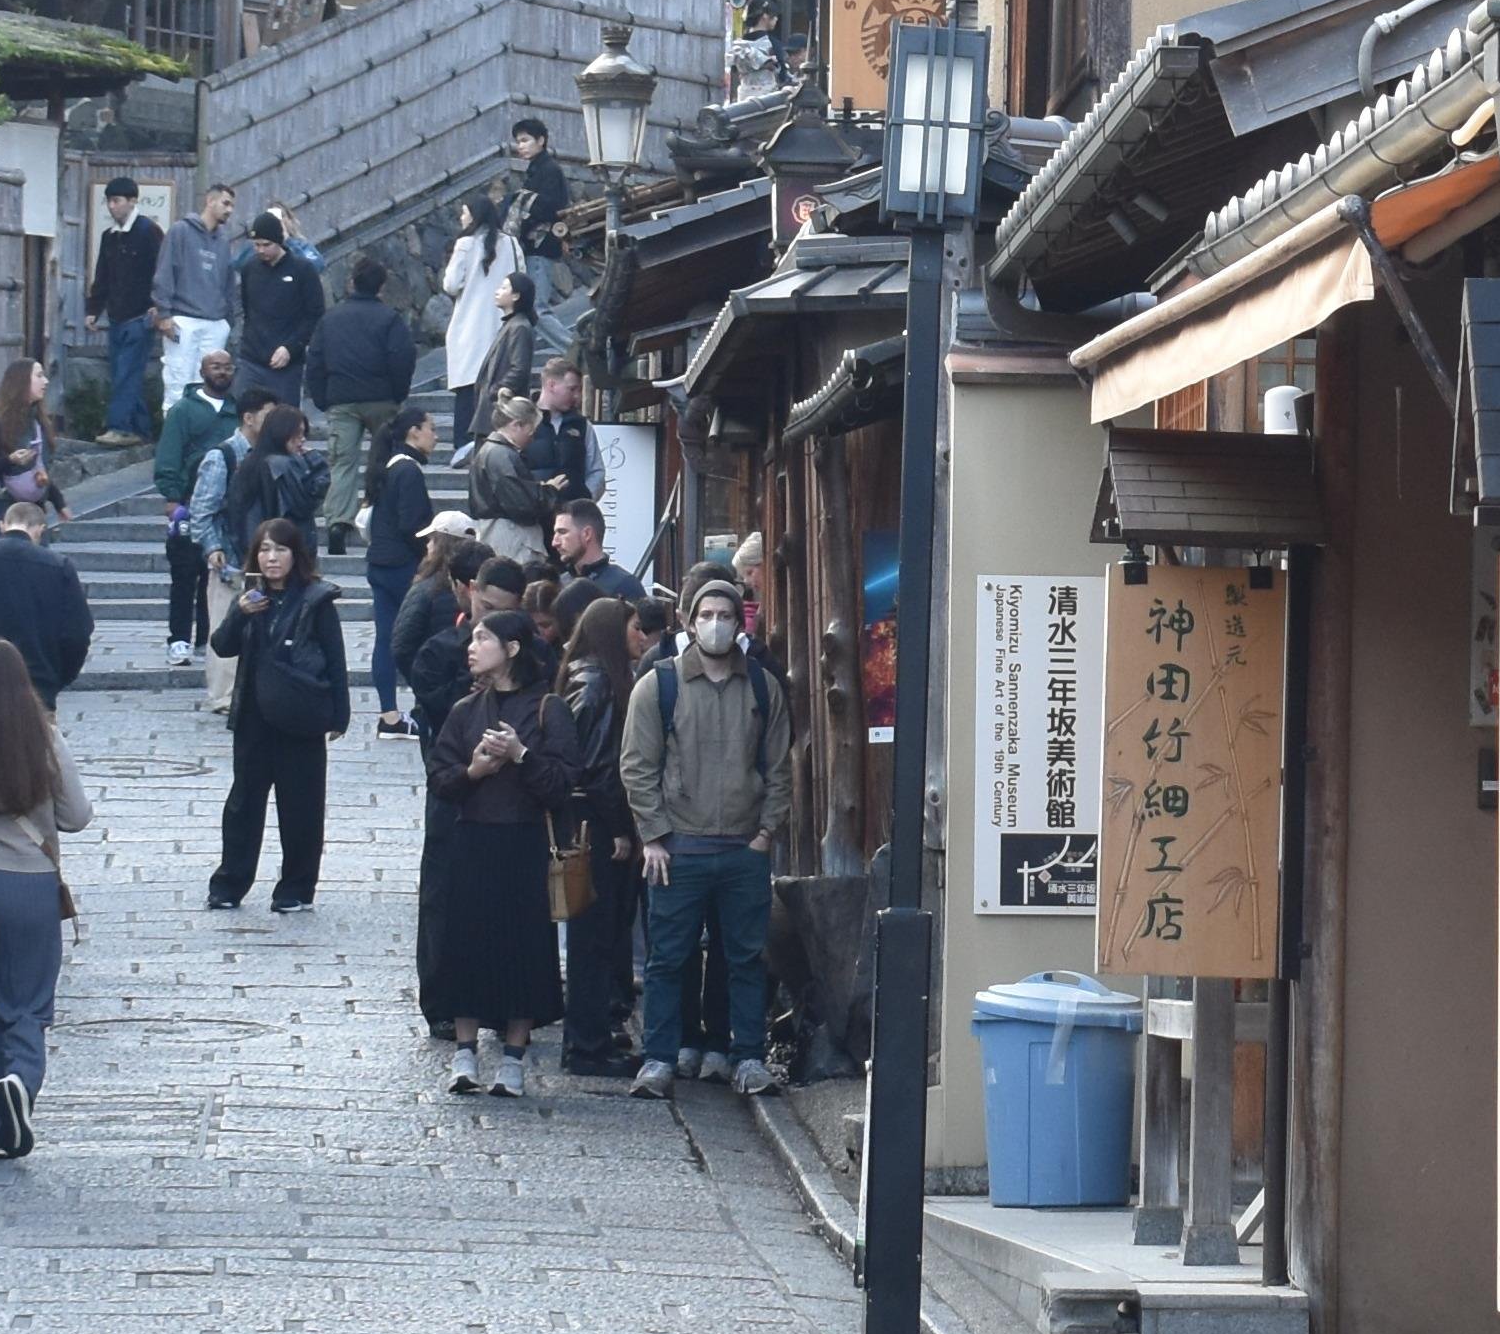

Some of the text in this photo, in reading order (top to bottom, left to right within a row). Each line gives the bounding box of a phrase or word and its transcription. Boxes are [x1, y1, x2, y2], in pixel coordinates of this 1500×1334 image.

[991, 584, 1007, 827] Japanese Fine Art of the 19th Century
[1007, 584, 1023, 828] Kiyomizu Sannenzaka Museum
[1046, 585, 1078, 828] 清水三年坂美術館
[1224, 583, 1248, 666] 製造元
[1140, 598, 1195, 941] 神田竹細工店
